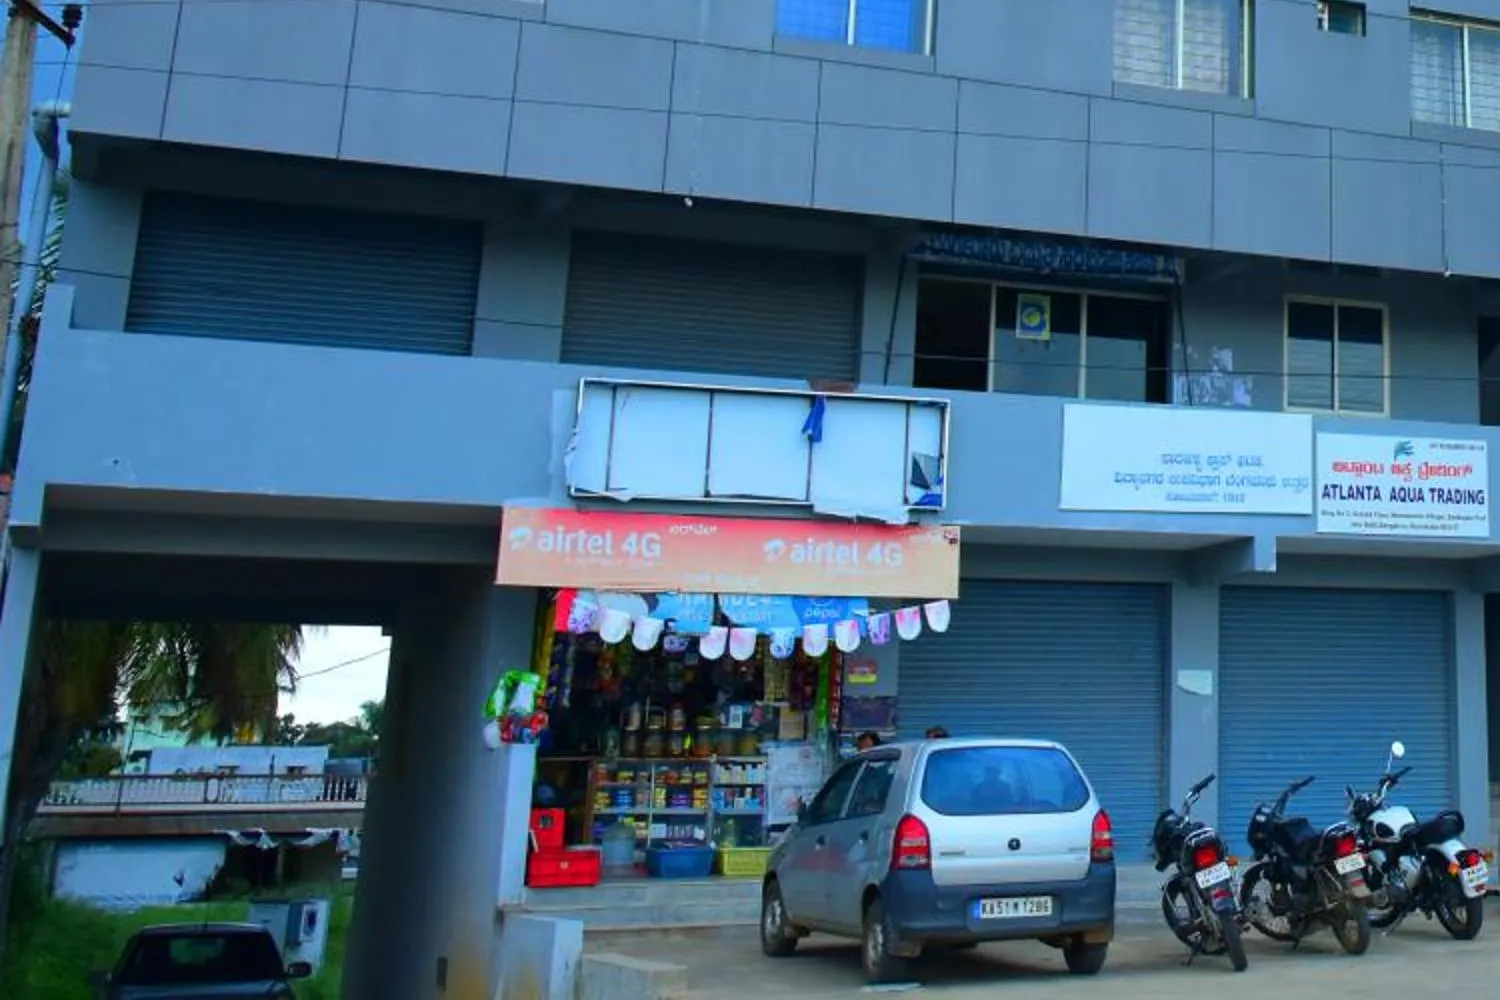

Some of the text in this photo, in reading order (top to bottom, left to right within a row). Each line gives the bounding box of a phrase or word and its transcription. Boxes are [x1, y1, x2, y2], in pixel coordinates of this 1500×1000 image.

[1321, 483, 1485, 506] ATLANTA AQUA TRADING
[537, 524, 614, 556] airtel
[621, 529, 663, 558] 4G
[789, 537, 904, 569] airtel 4G
